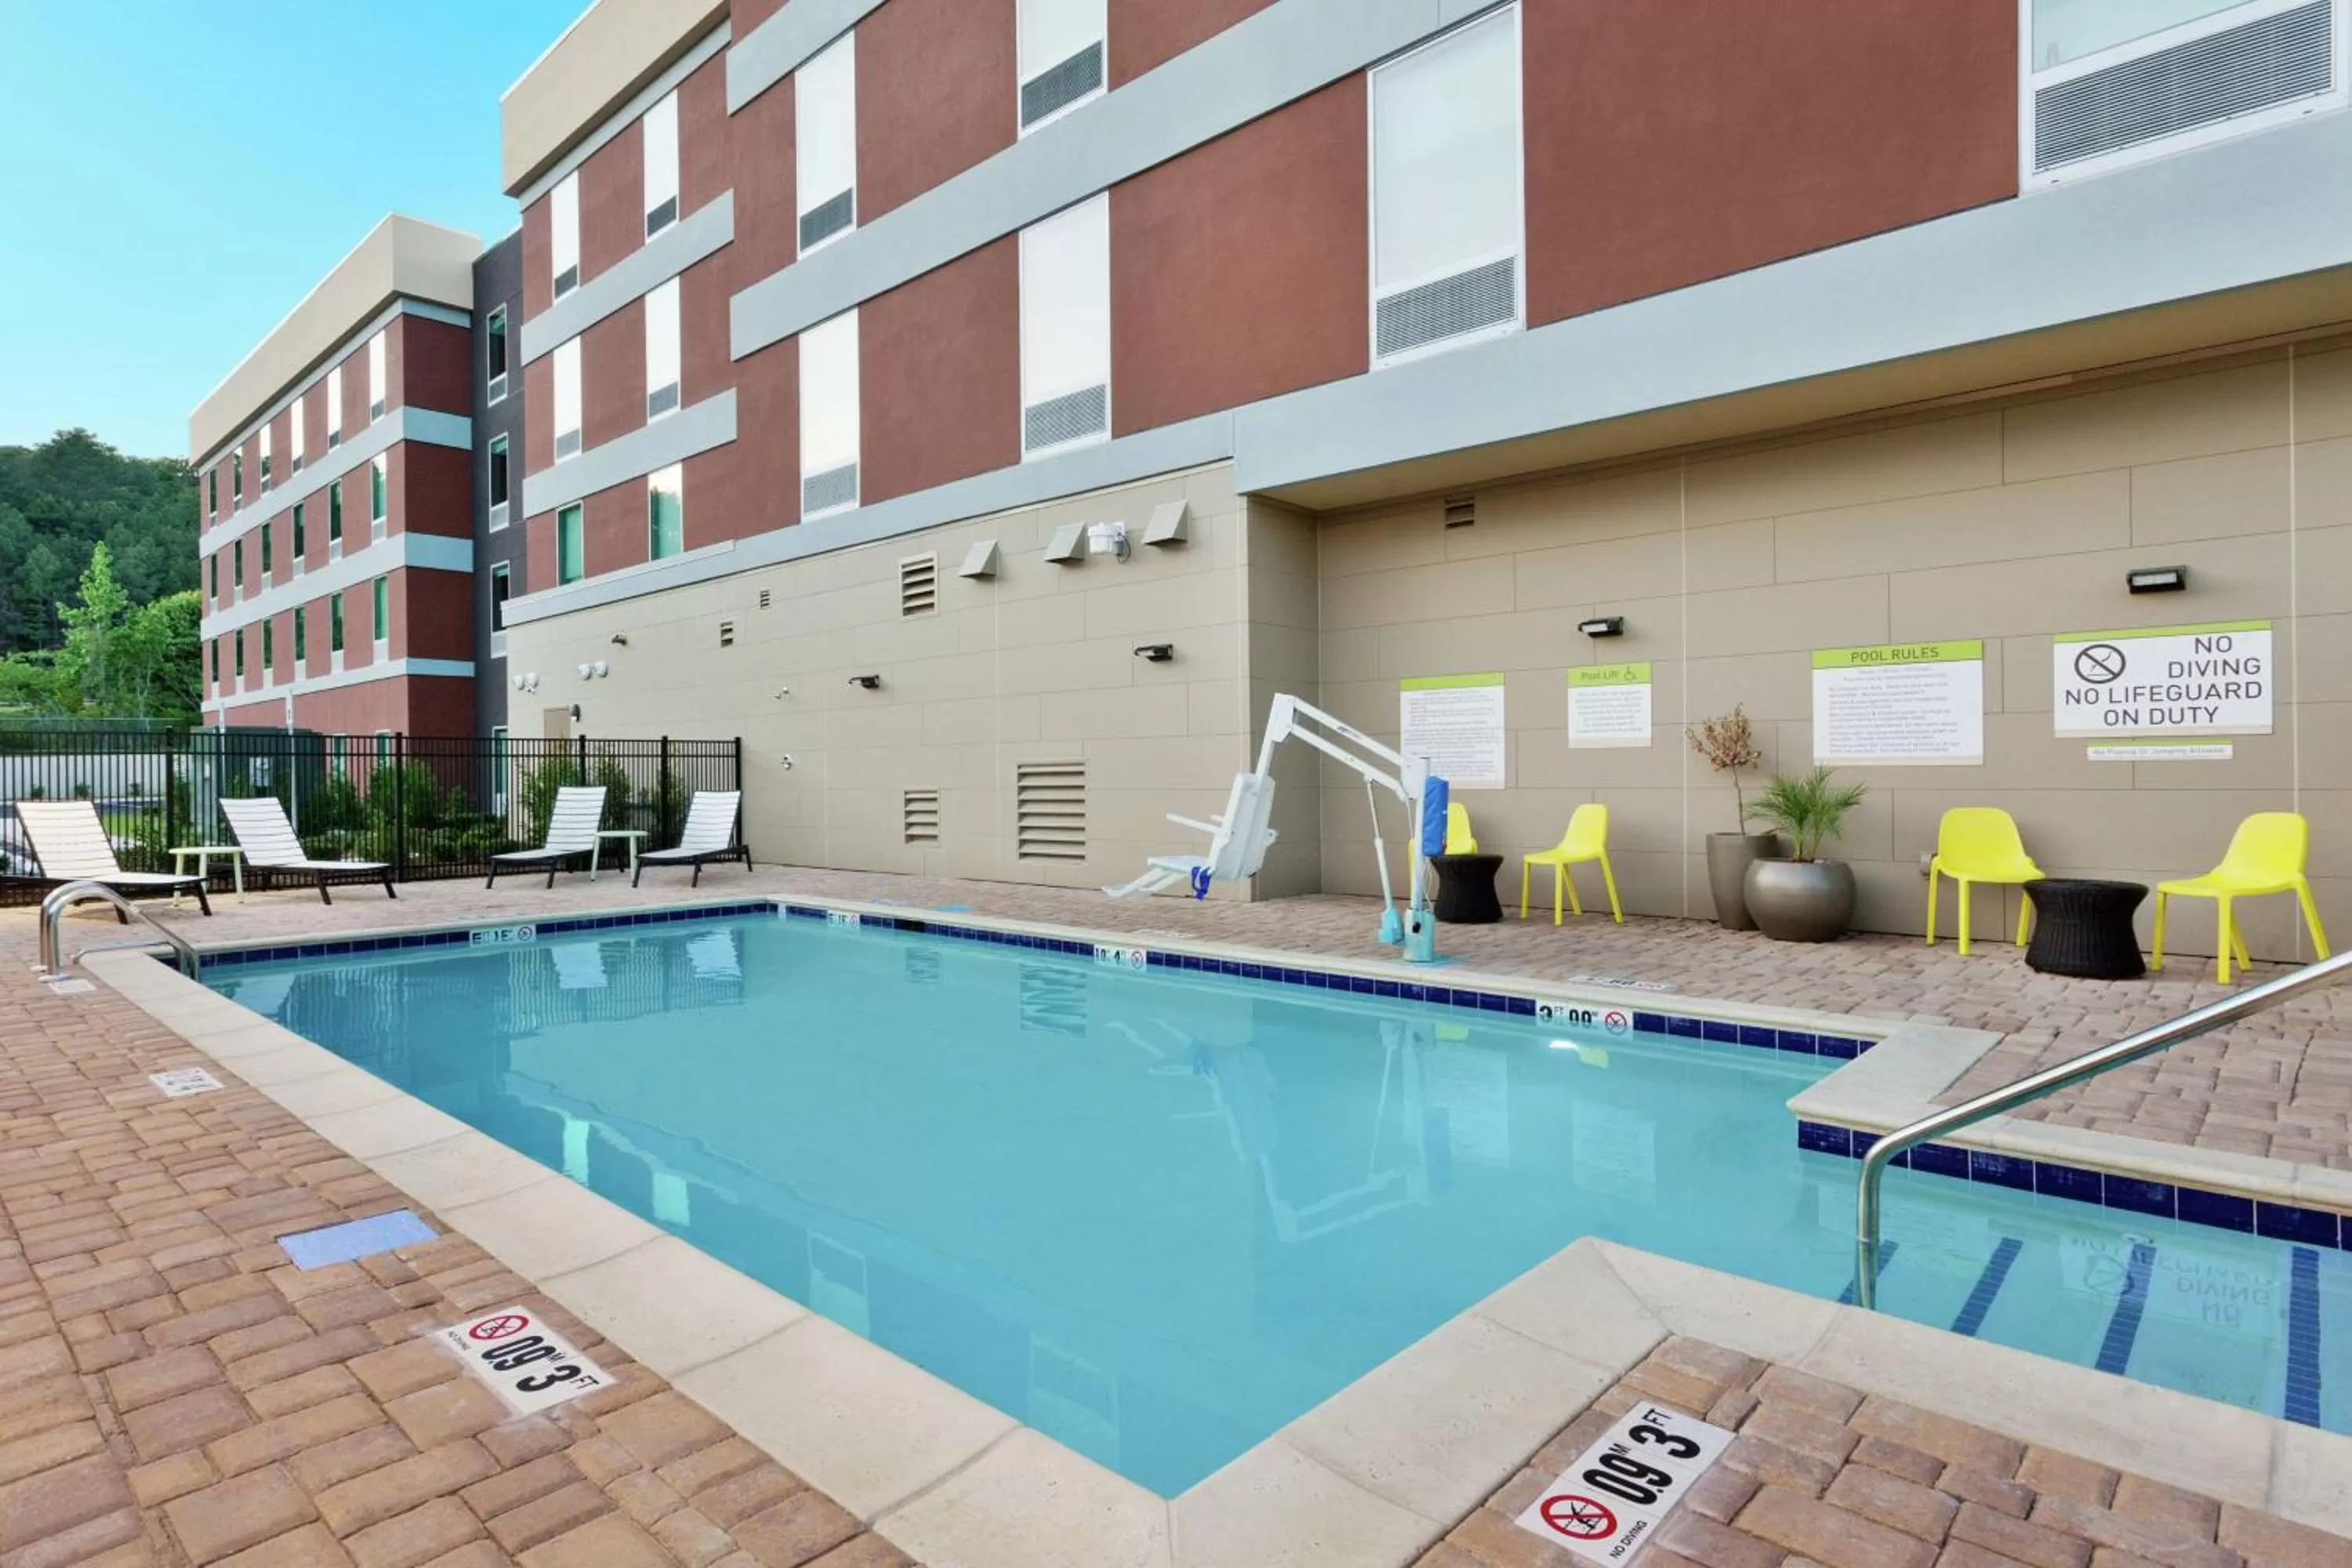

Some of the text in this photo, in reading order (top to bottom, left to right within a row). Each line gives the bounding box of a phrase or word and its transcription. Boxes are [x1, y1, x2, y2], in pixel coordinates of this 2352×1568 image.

[1850, 646, 1940, 663] POOL RULES
[2194, 635, 2232, 654] NO
[2168, 657, 2261, 678] DIVING
[2065, 681, 2263, 706] NO LIFEGUARD
[2103, 705, 2220, 726] ON DUTY
[1642, 1408, 1673, 1427] FT
[1628, 1424, 1701, 1460] 3
[1610, 1519, 1648, 1559] NO DIVING
